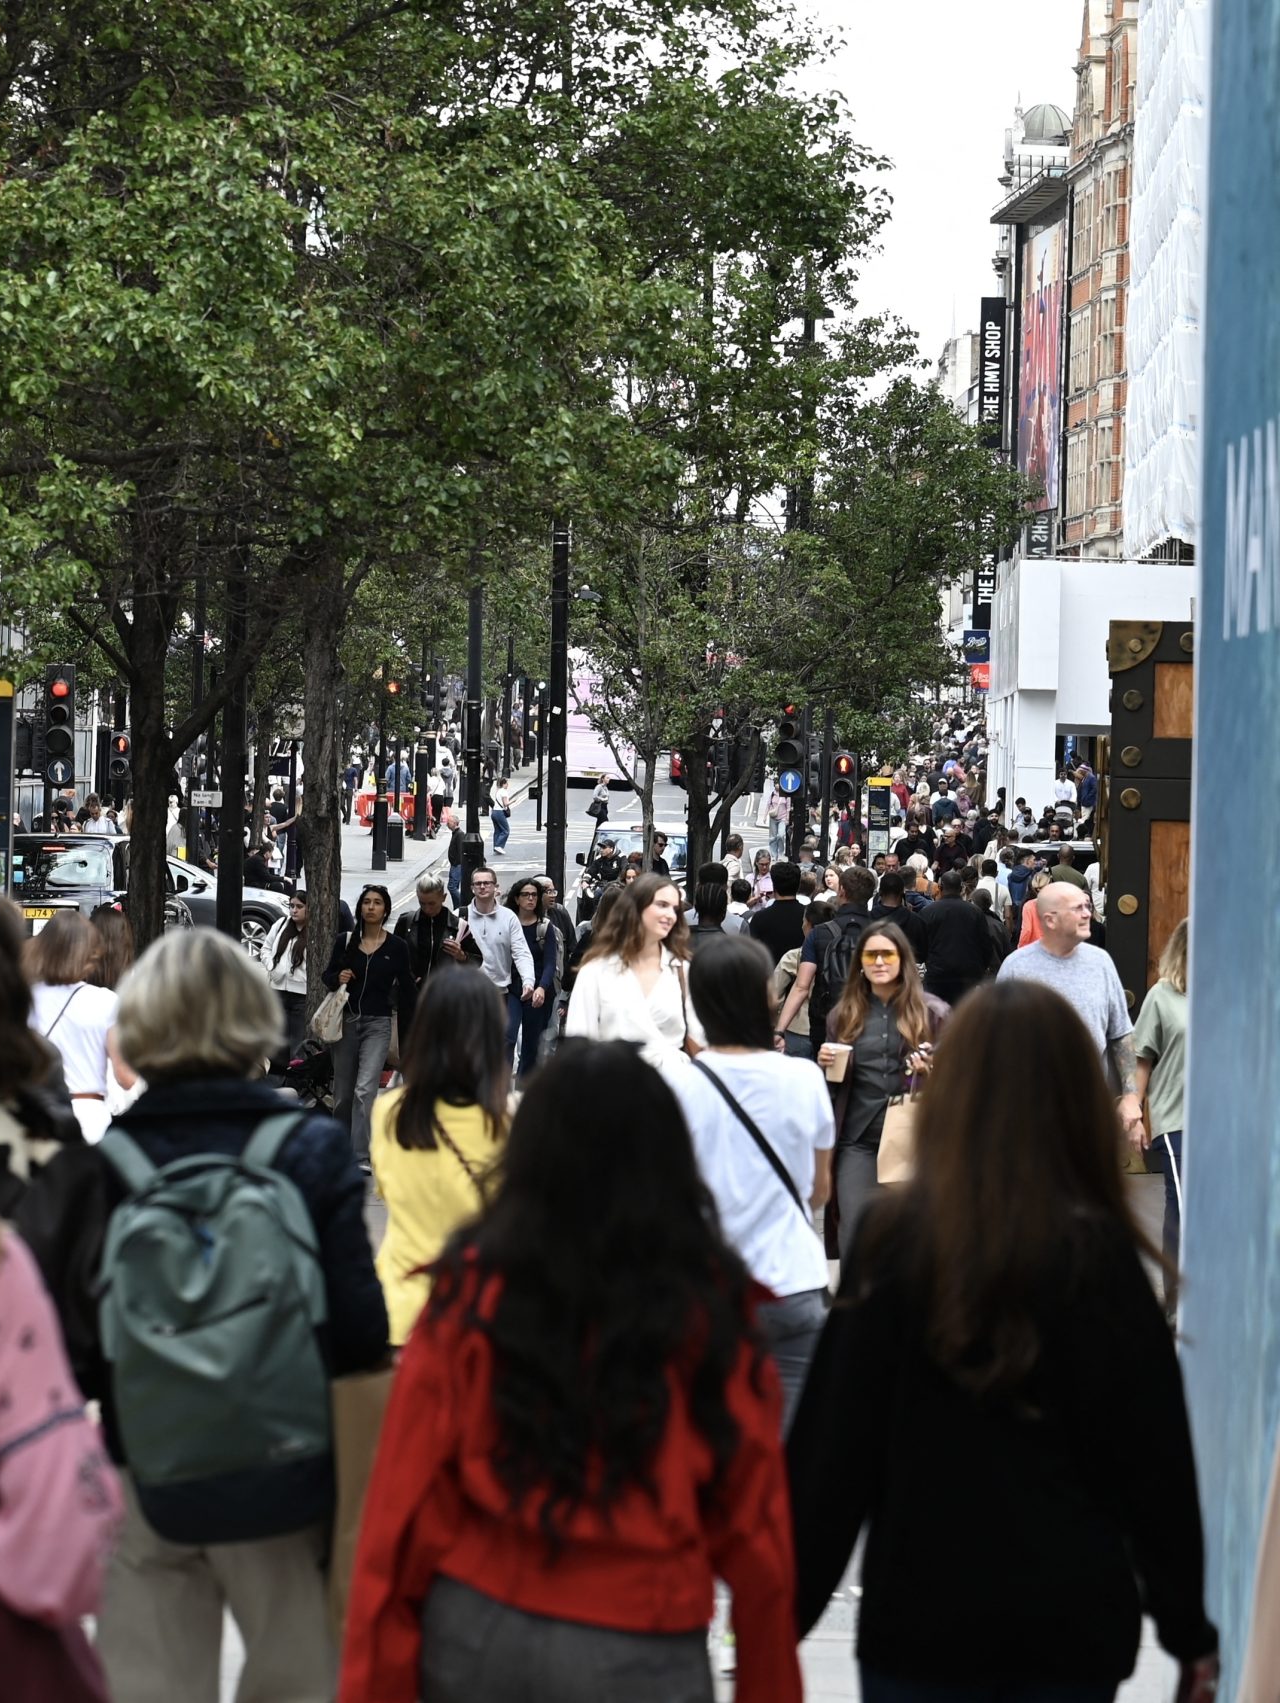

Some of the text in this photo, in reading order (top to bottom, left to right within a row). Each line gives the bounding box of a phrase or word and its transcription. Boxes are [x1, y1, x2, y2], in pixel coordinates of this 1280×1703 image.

[983, 321, 1001, 421] THE HMV SHOP
[977, 578, 994, 605] THE
[25, 909, 47, 917] LJ74
